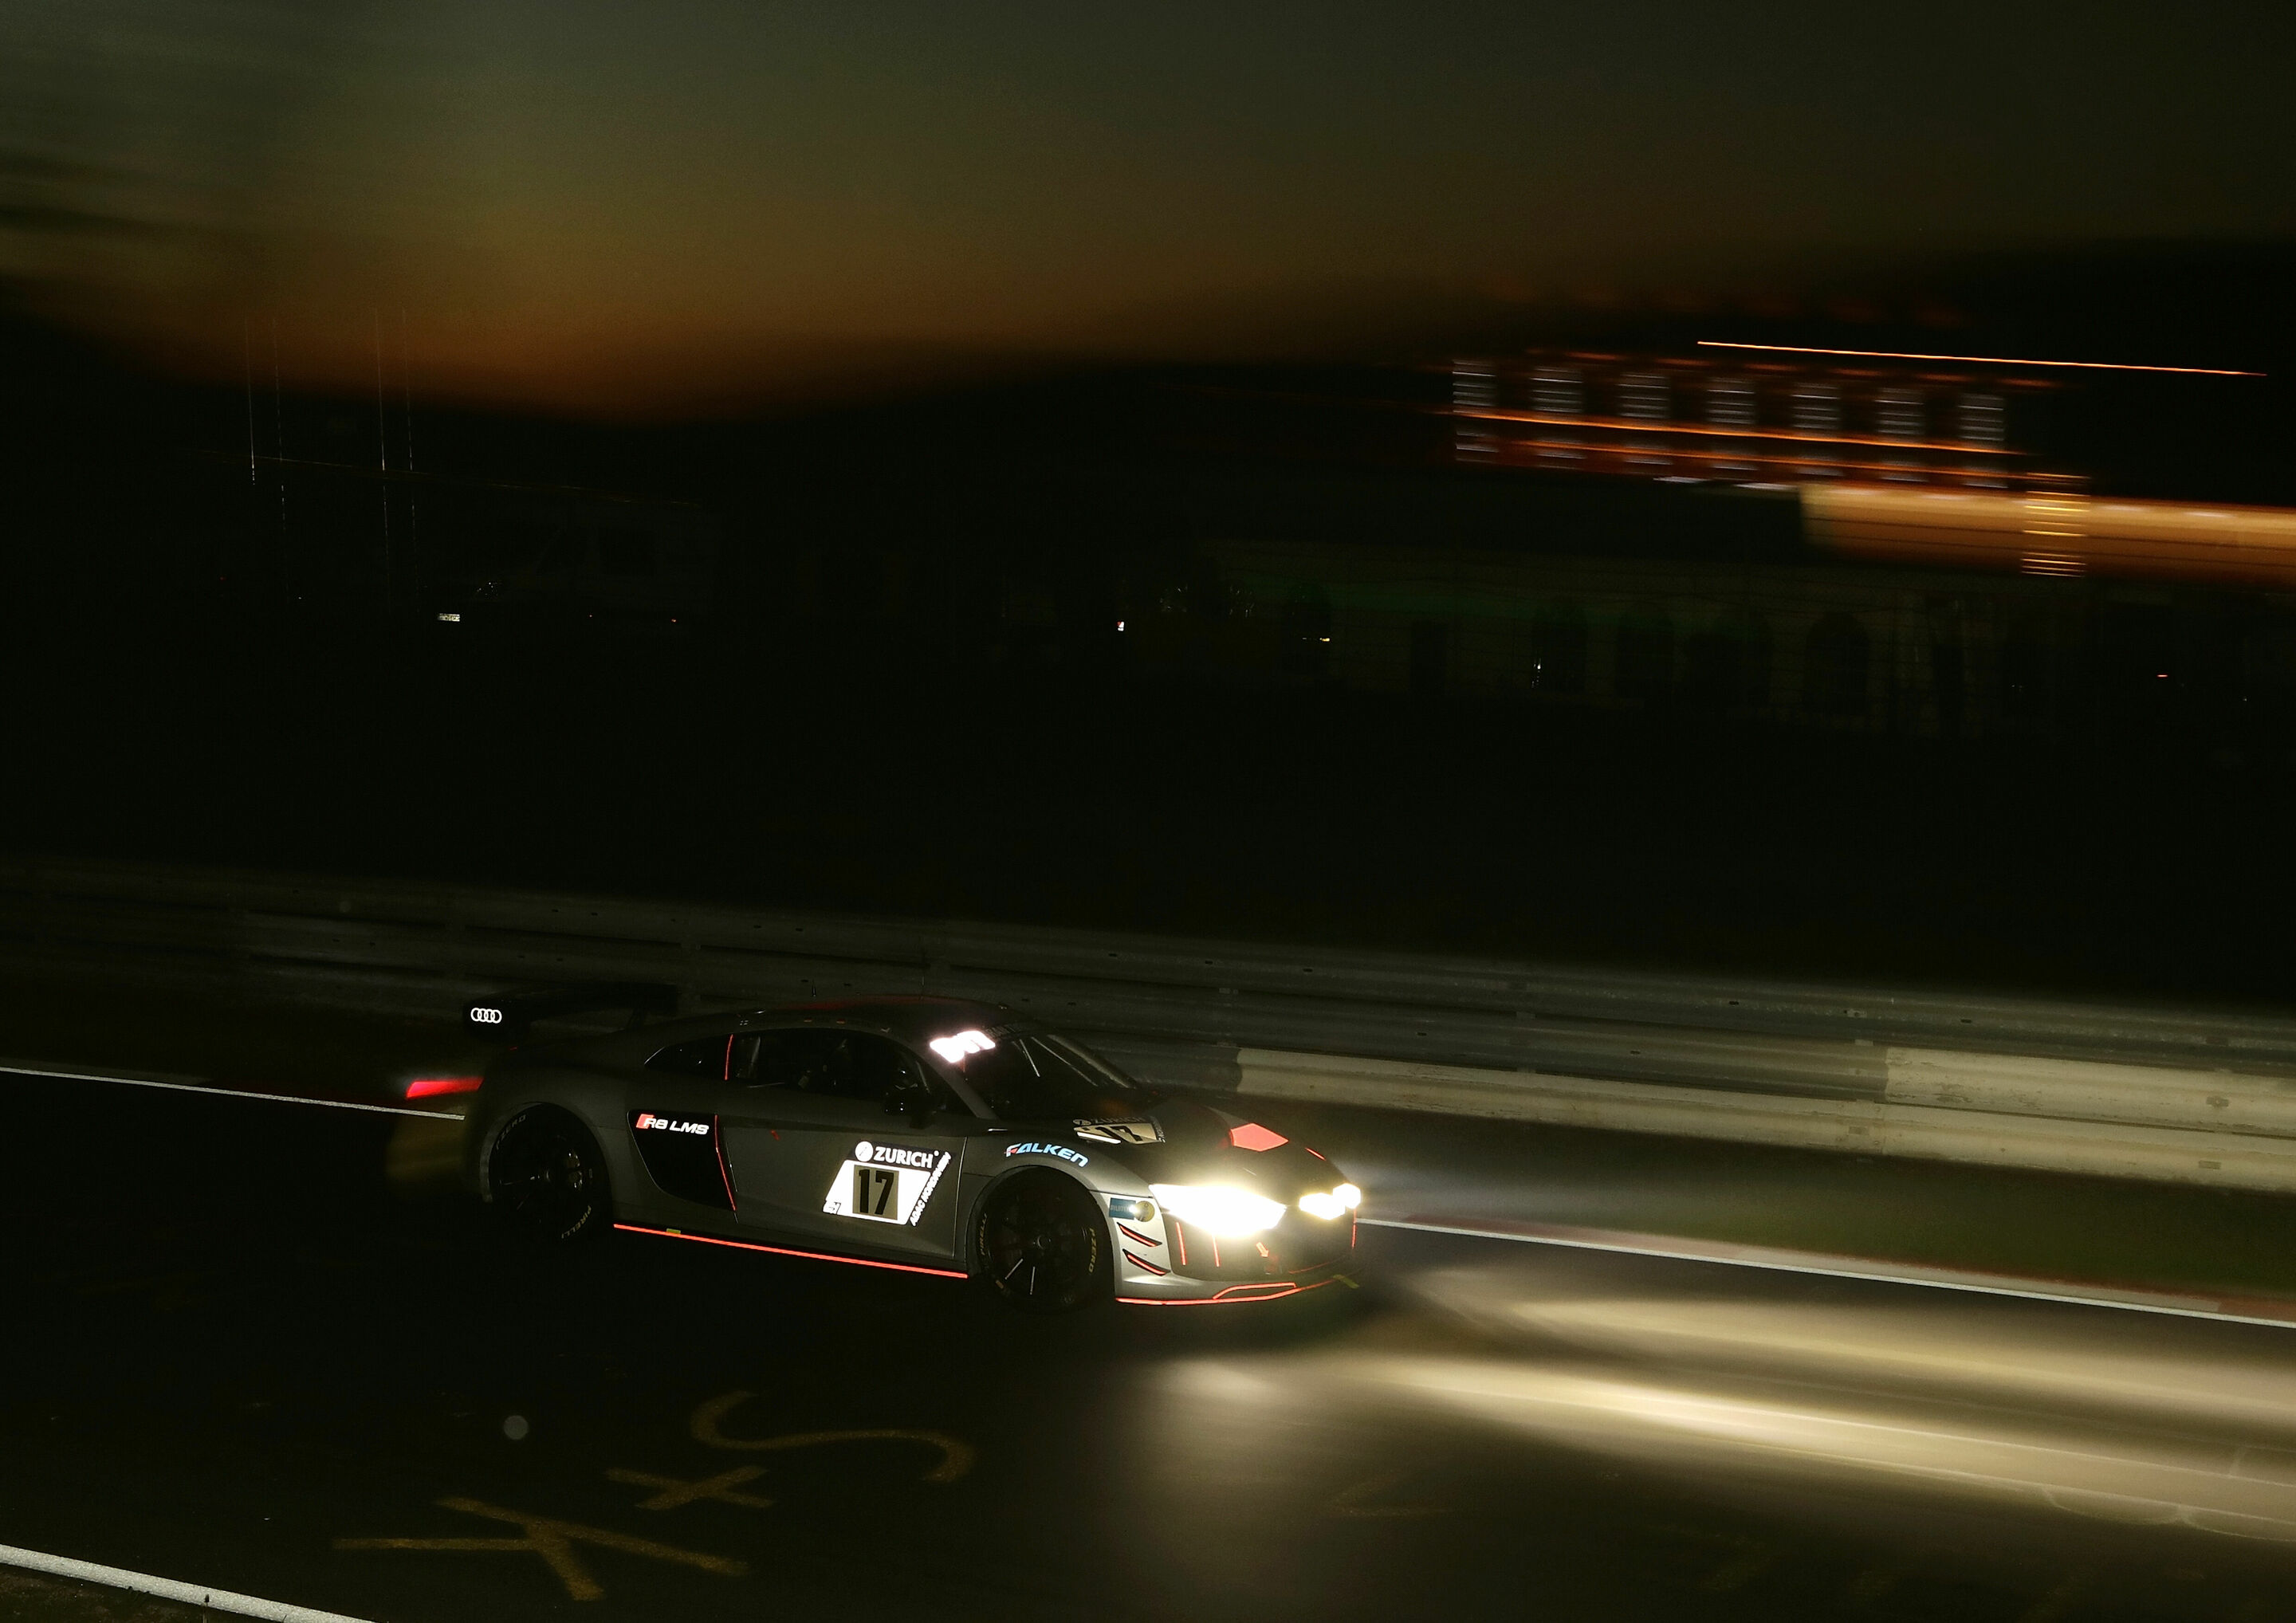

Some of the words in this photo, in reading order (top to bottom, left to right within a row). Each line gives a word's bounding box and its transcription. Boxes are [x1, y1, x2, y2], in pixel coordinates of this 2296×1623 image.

[643, 1118, 669, 1130] R8
[669, 1121, 710, 1135] LMS
[1095, 1125, 1143, 1142] 17
[873, 1146, 934, 1169] ZURICH
[1005, 1142, 1090, 1167] FALKEN
[859, 1169, 894, 1215] 17
[910, 1199, 926, 1227] ADAC
[980, 1212, 989, 1256] PIRELLI
